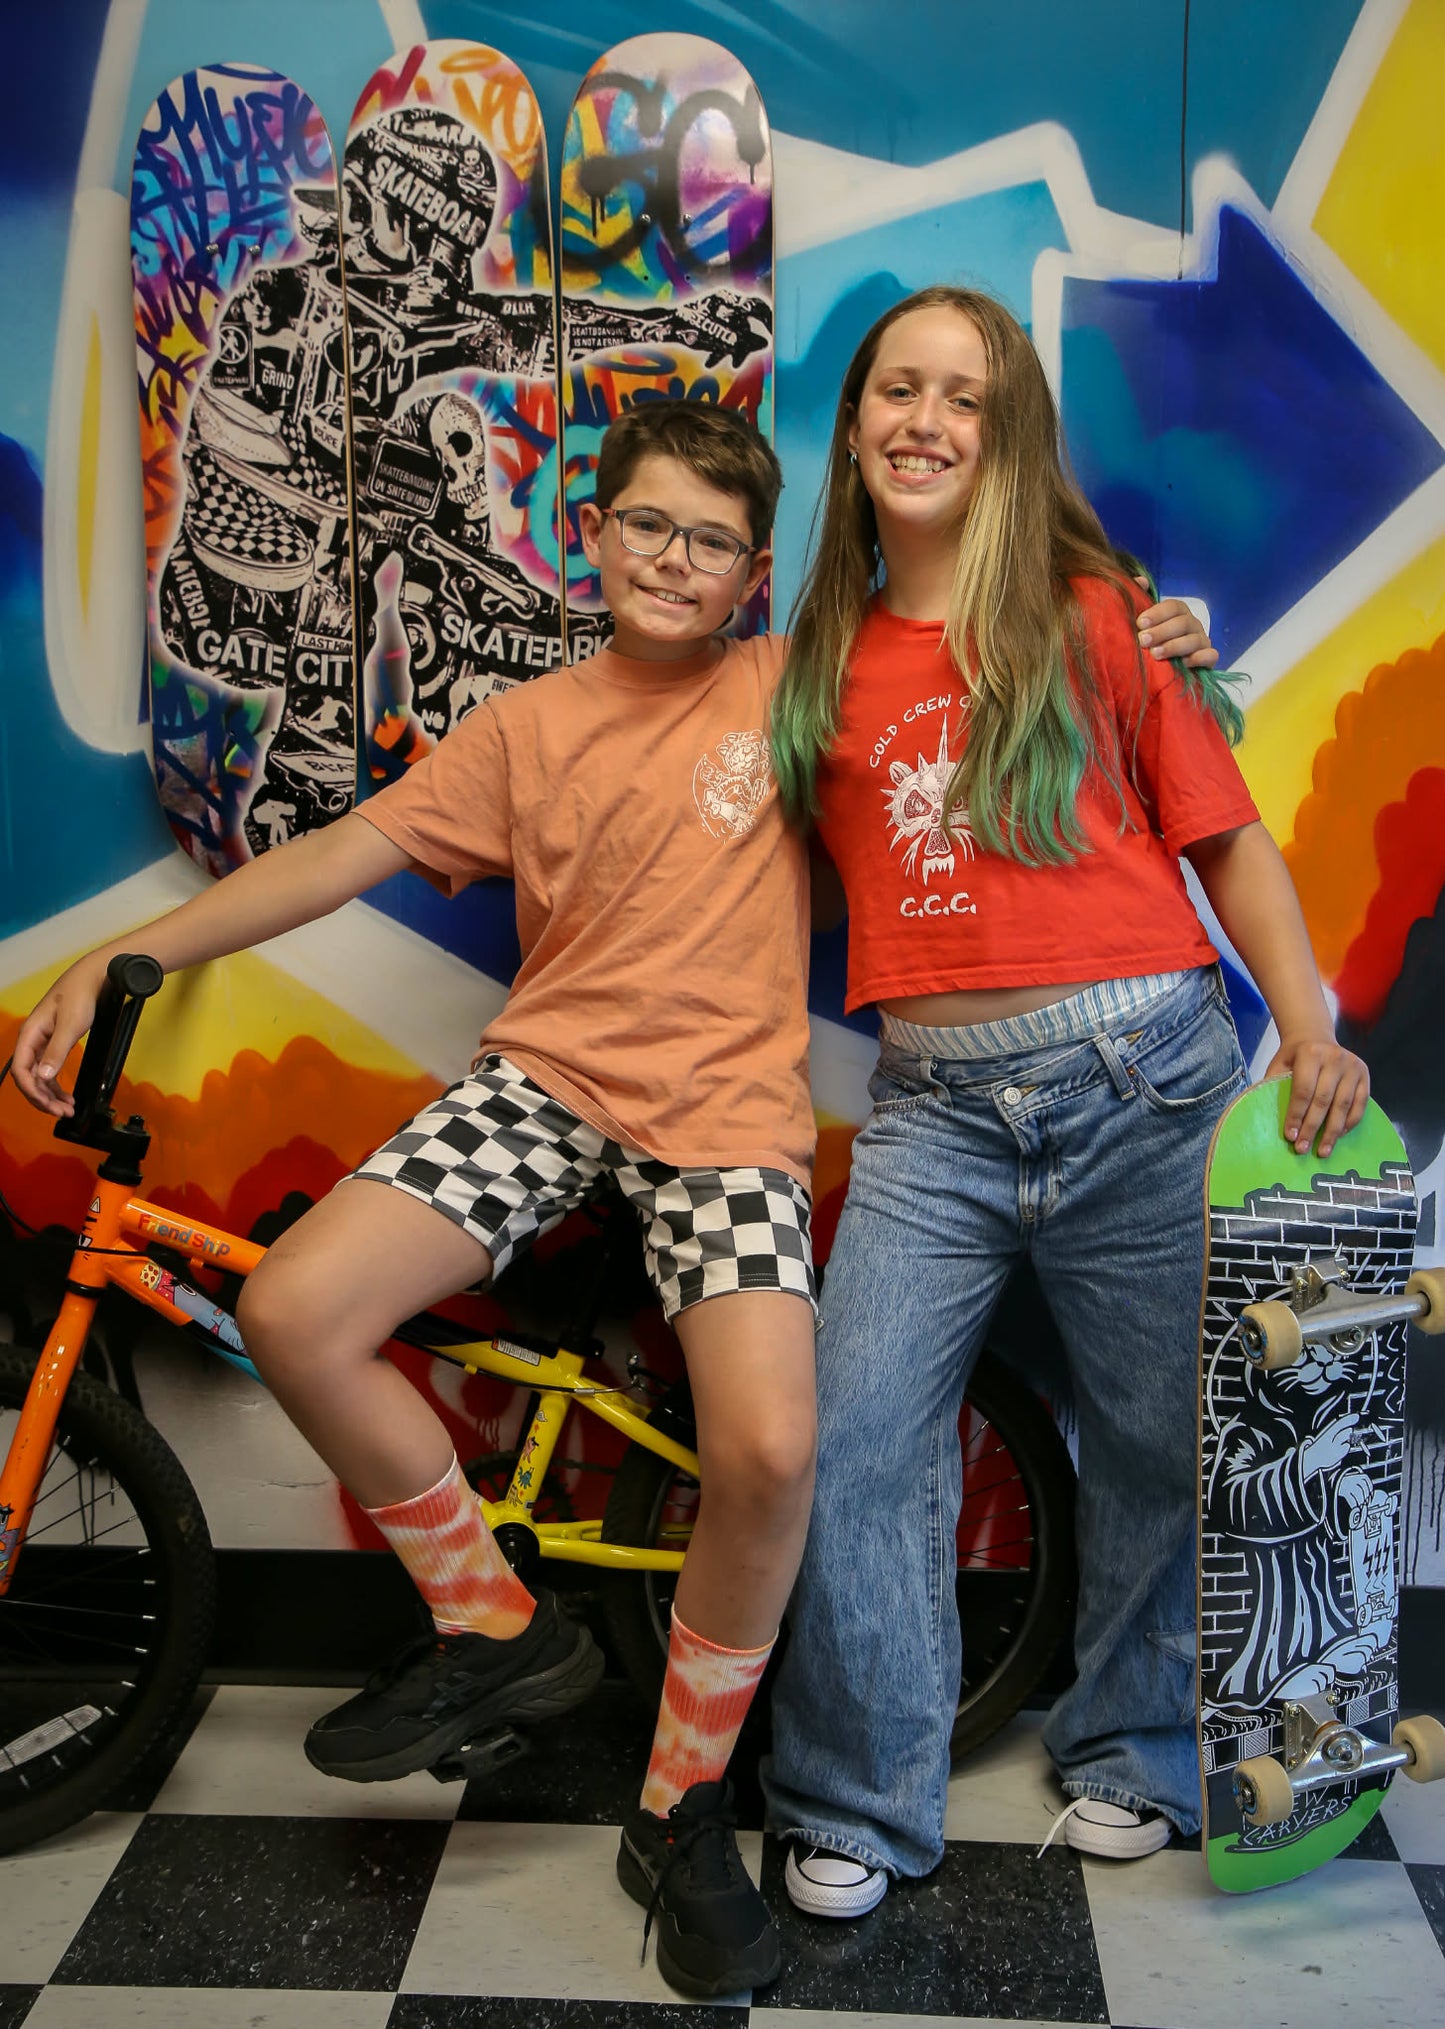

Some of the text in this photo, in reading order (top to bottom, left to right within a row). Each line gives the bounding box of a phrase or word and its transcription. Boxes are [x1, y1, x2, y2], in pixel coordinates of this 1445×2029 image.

[262, 368, 295, 390] GRIND
[197, 629, 287, 679] GATE
[295, 652, 355, 687] CIT
[301, 634, 333, 650] LAST
[869, 724, 898, 768] COLD
[903, 693, 951, 722] CREW
[900, 892, 977, 918] C.C.C.
[138, 1213, 231, 1257] Friend Ship
[1243, 1796, 1352, 1846] CARVERS
